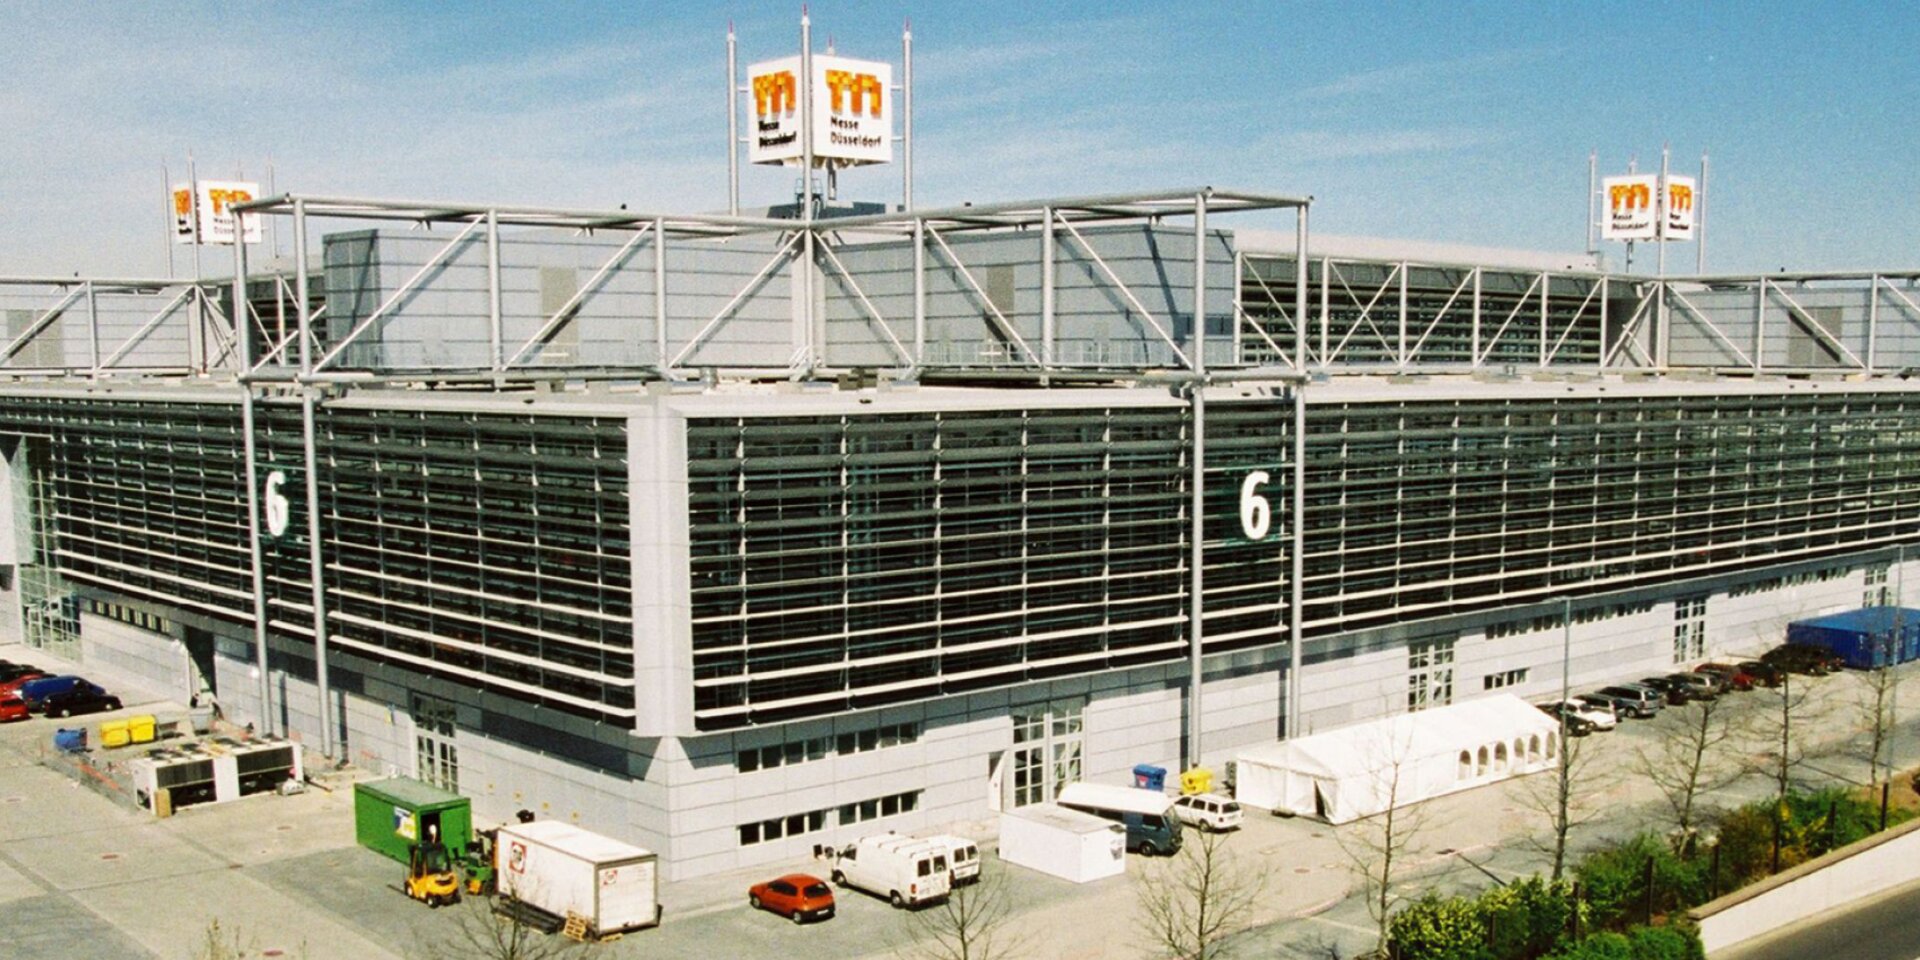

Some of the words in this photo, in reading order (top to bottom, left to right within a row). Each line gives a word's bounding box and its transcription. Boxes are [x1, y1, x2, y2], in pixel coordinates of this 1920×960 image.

[831, 116, 859, 130] Messe
[831, 133, 882, 147] Düsseldorf
[265, 471, 289, 537] 6
[1240, 471, 1270, 539] 6
